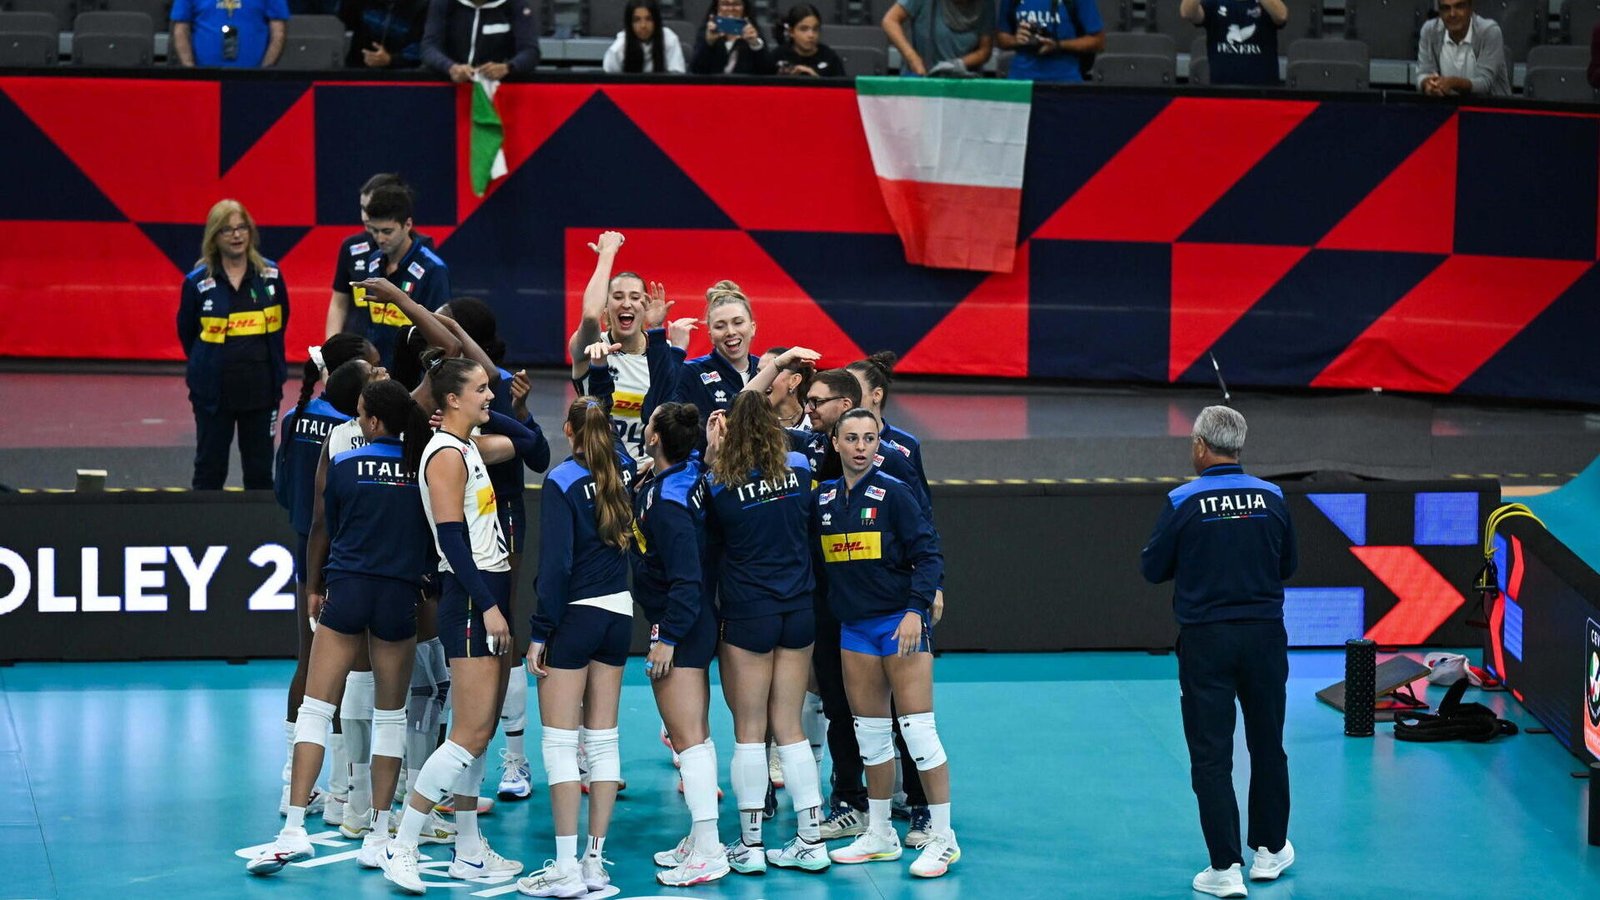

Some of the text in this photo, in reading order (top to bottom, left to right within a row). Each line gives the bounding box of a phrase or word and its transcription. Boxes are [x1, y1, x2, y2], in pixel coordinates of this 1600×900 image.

[296, 418, 333, 436] ITALI
[358, 461, 417, 478] ITAL
[738, 473, 799, 501] ITALIA
[1200, 494, 1267, 513] ITALIA
[832, 541, 864, 552] DHL
[248, 544, 298, 611] 2
